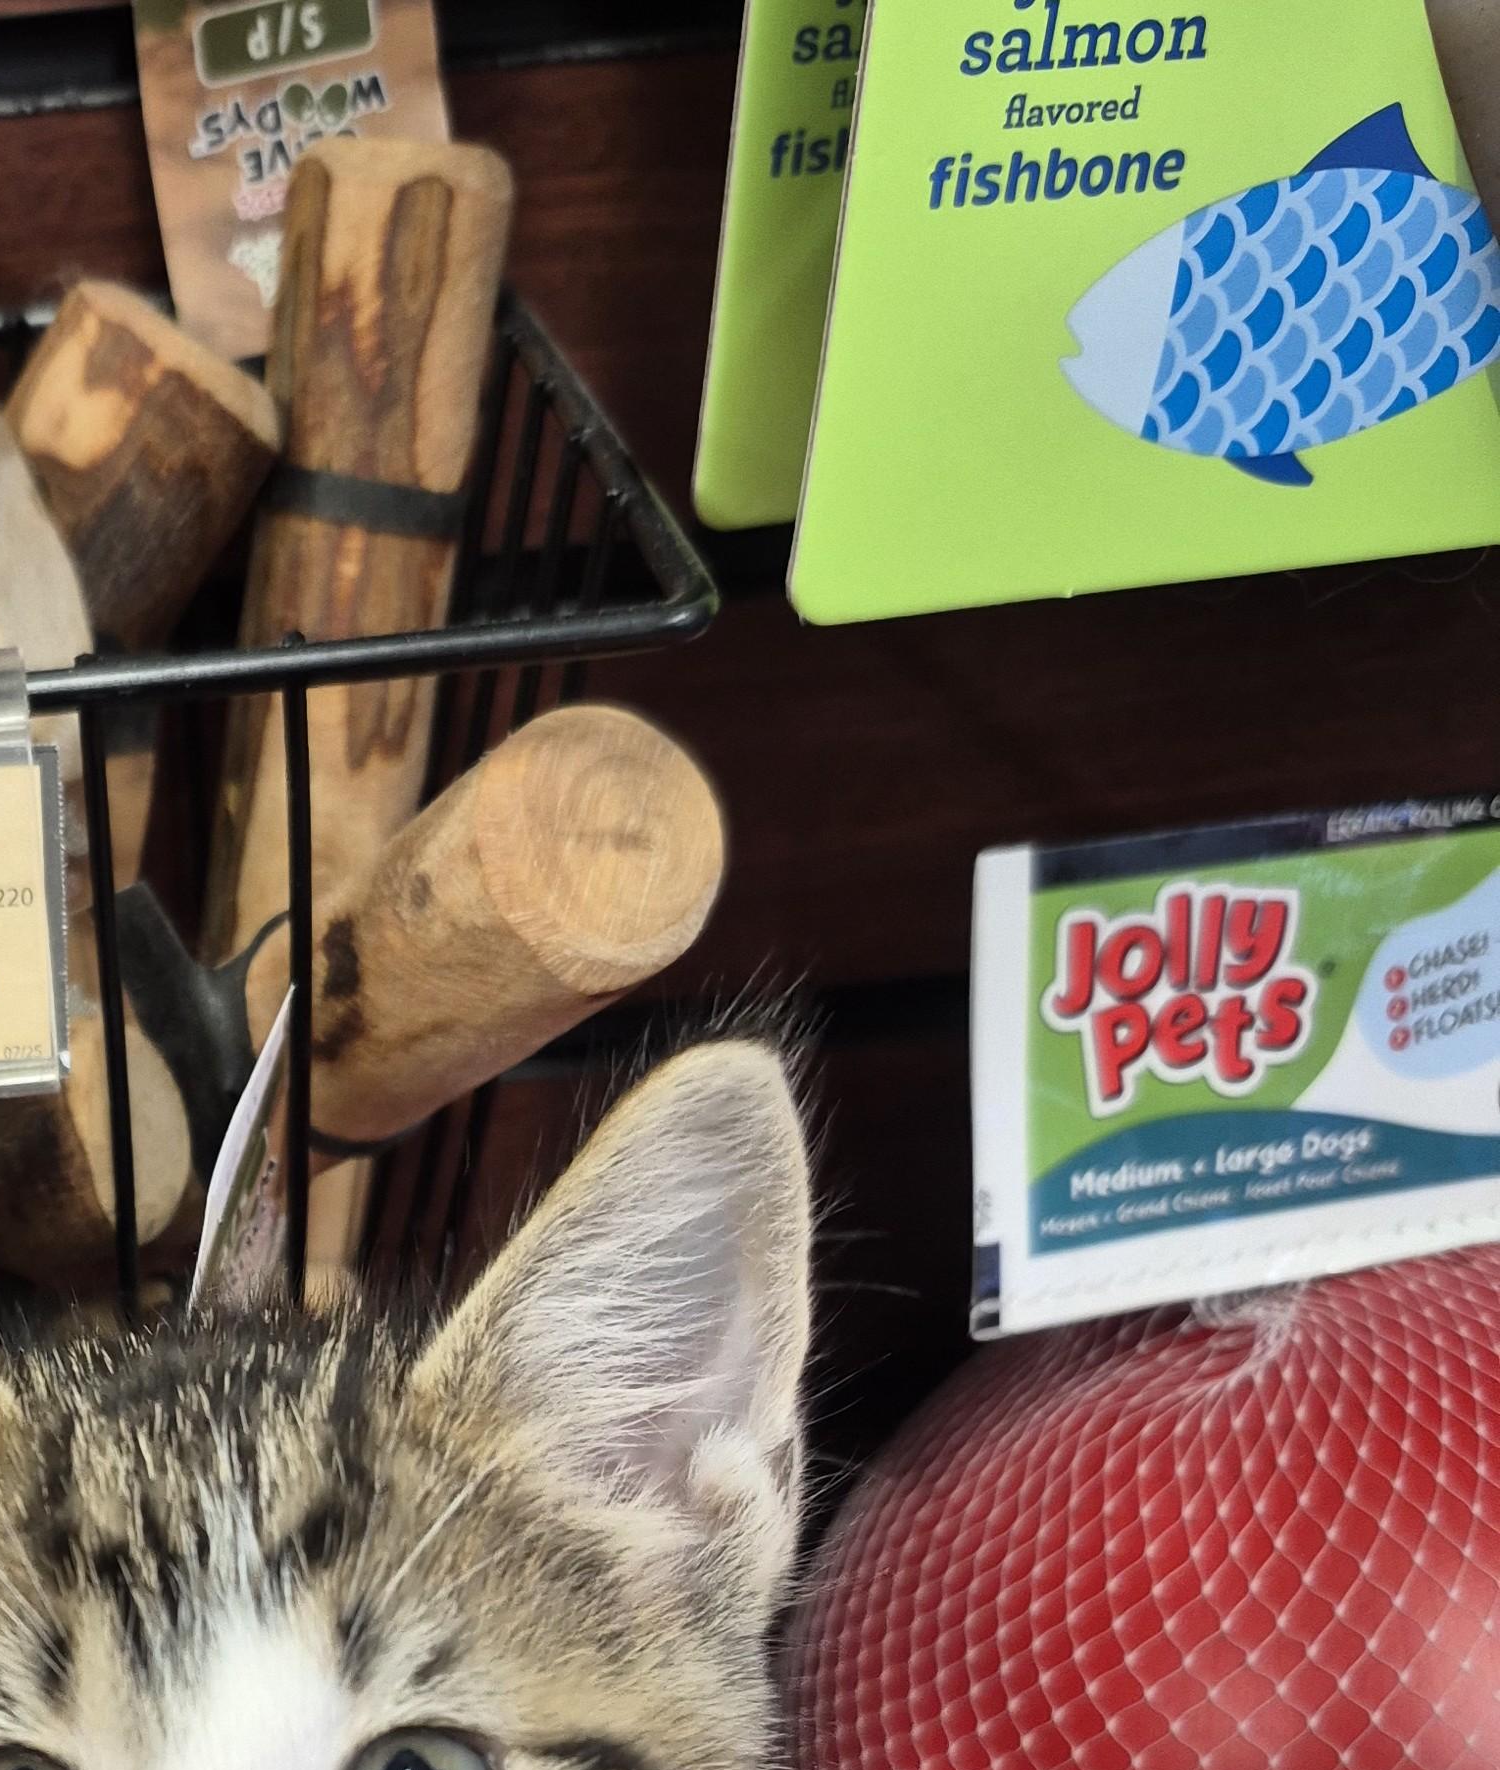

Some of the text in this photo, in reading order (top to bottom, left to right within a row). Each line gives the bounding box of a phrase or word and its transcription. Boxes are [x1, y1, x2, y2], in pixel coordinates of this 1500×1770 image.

[246, 3, 325, 61] S/P
[959, 0, 1207, 76] salmon
[1002, 84, 1142, 130] flavored
[928, 147, 1186, 210] fishbone
[1051, 891, 1290, 1018] Jolly
[1070, 1160, 1184, 1200] Medium
[1214, 1138, 1296, 1176] Large
[1301, 1126, 1374, 1161] Dogs
